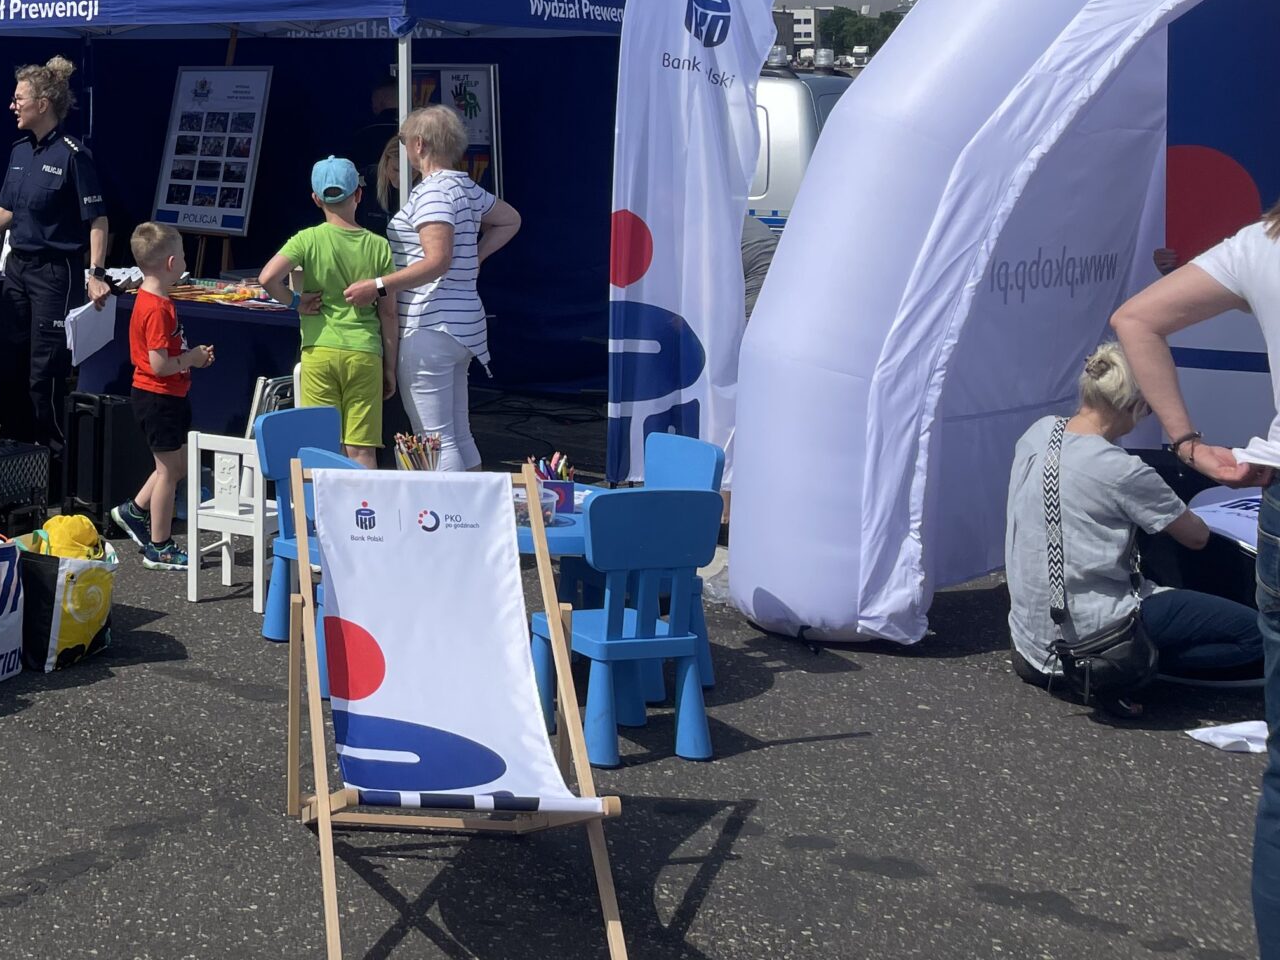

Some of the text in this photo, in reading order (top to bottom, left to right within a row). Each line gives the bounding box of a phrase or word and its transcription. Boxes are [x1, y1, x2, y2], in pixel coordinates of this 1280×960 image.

[661, 52, 736, 89] Bank lski
[41, 164, 63, 176] POLICJA
[182, 212, 218, 225] POLICJA
[444, 513, 462, 523] PKO
